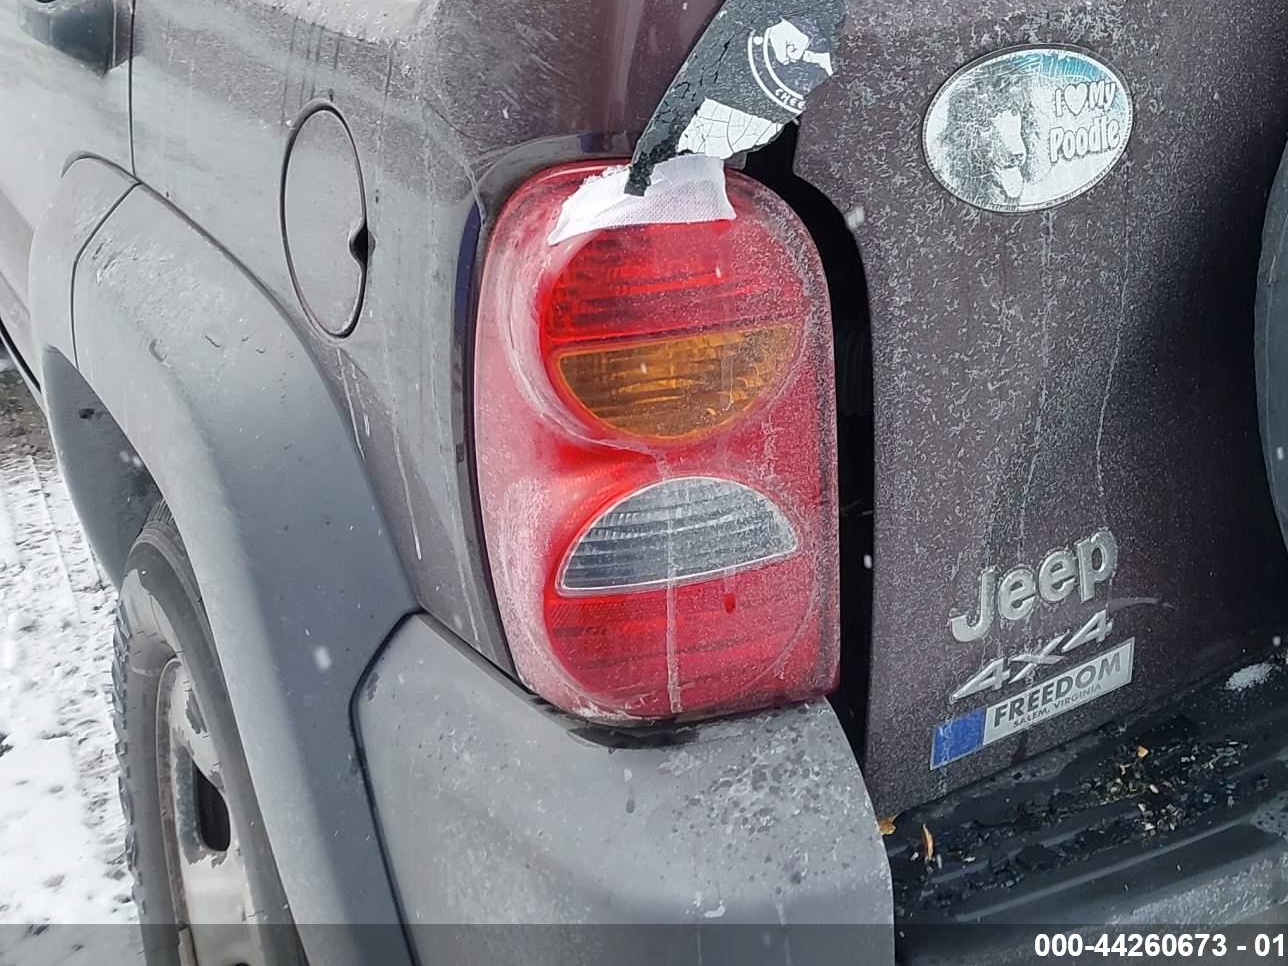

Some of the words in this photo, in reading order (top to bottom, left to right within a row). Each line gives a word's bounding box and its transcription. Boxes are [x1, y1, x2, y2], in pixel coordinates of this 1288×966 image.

[1054, 88, 1064, 117] I
[1088, 80, 1117, 110] My
[1049, 115, 1121, 164] Poodle
[949, 528, 1119, 643] Jeep
[993, 651, 1122, 727] FREEDOM
[1053, 683, 1102, 709] VIRGINIA
